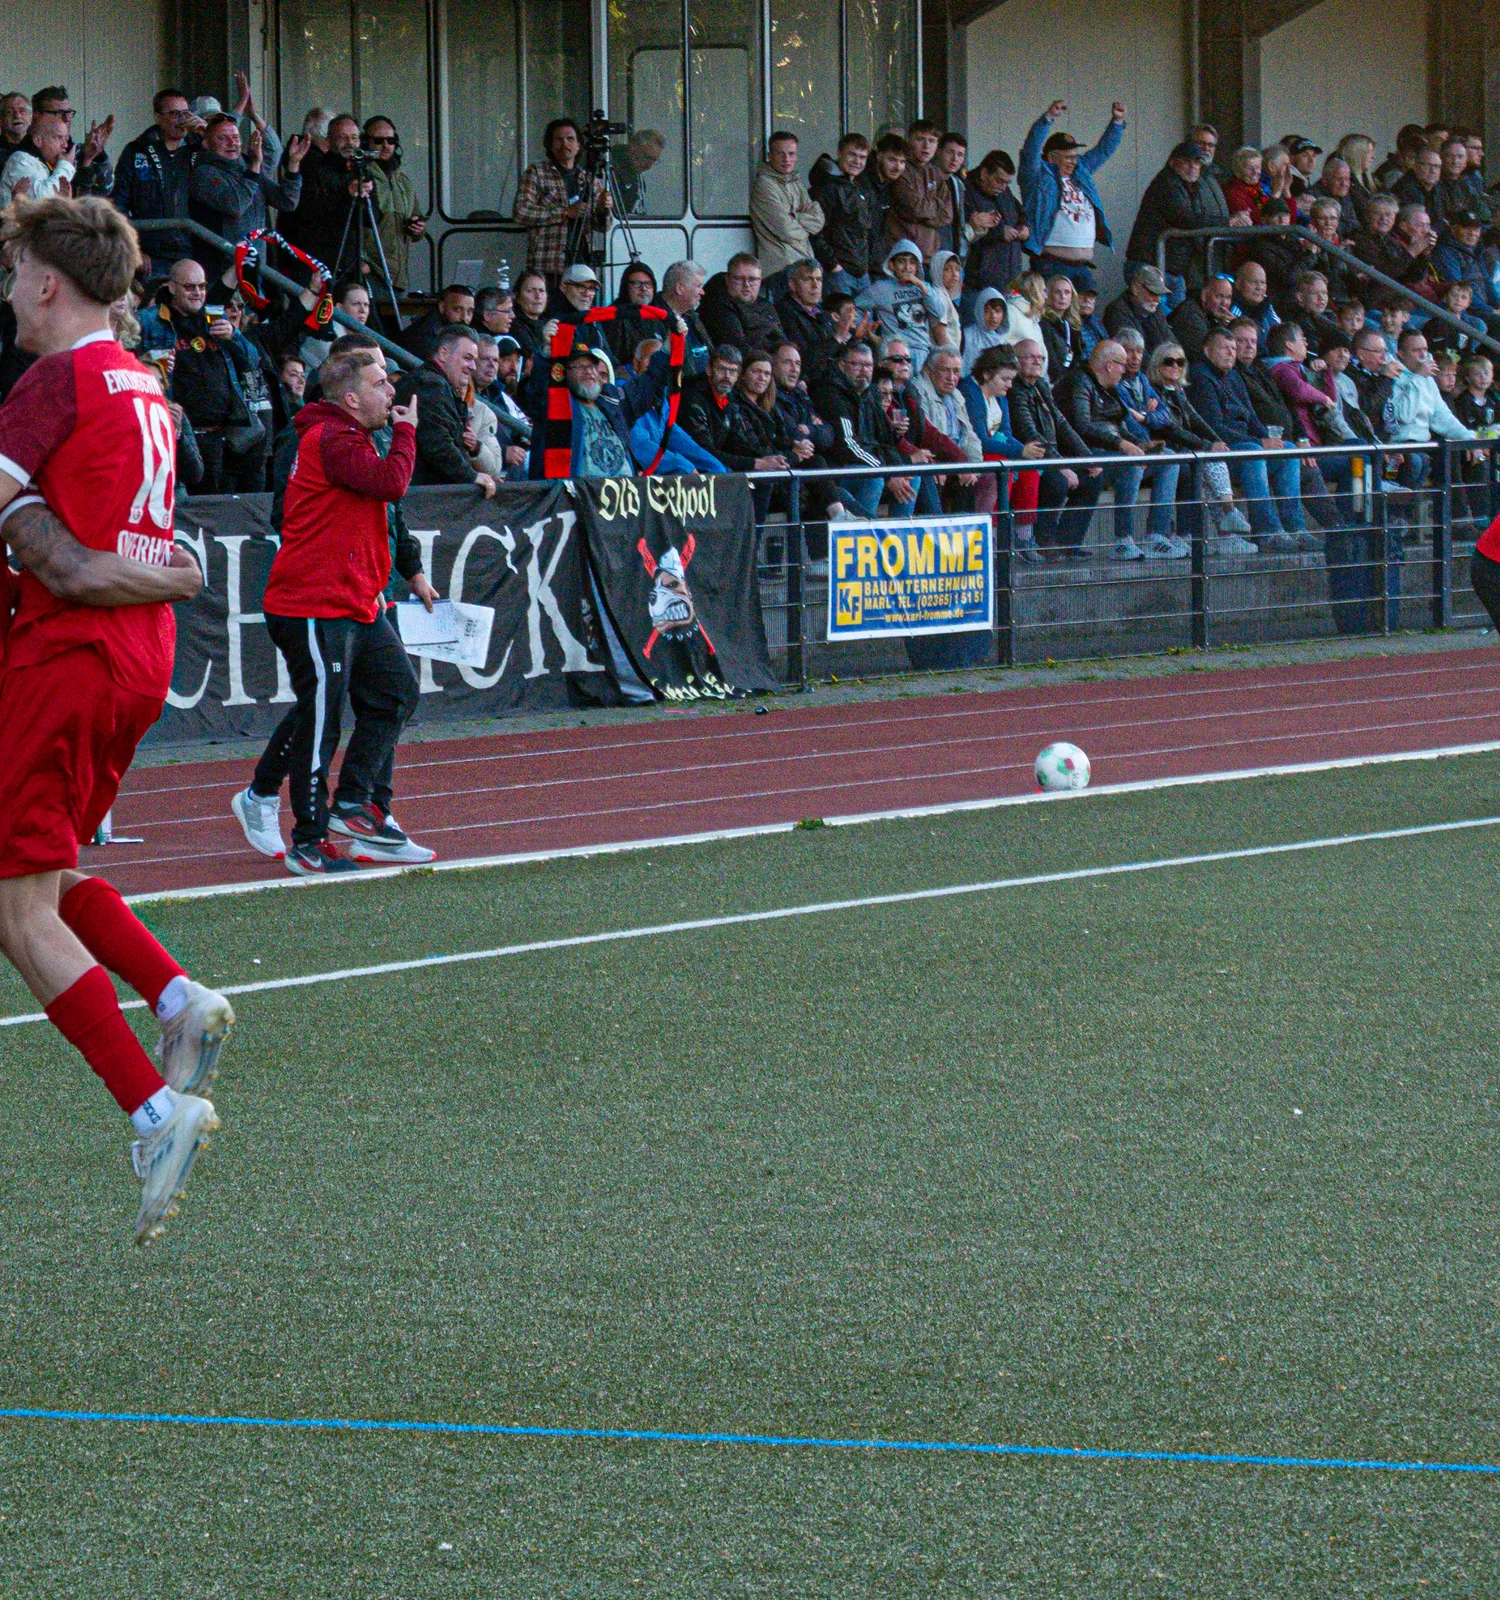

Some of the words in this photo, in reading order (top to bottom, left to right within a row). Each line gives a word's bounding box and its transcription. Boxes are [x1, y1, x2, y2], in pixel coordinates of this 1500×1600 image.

[599, 478, 641, 521] Old
[647, 476, 717, 526] School
[837, 530, 983, 579] FROMME
[864, 574, 984, 596] BAUUNTERNEHMUNG
[918, 594, 952, 610] (02365)
